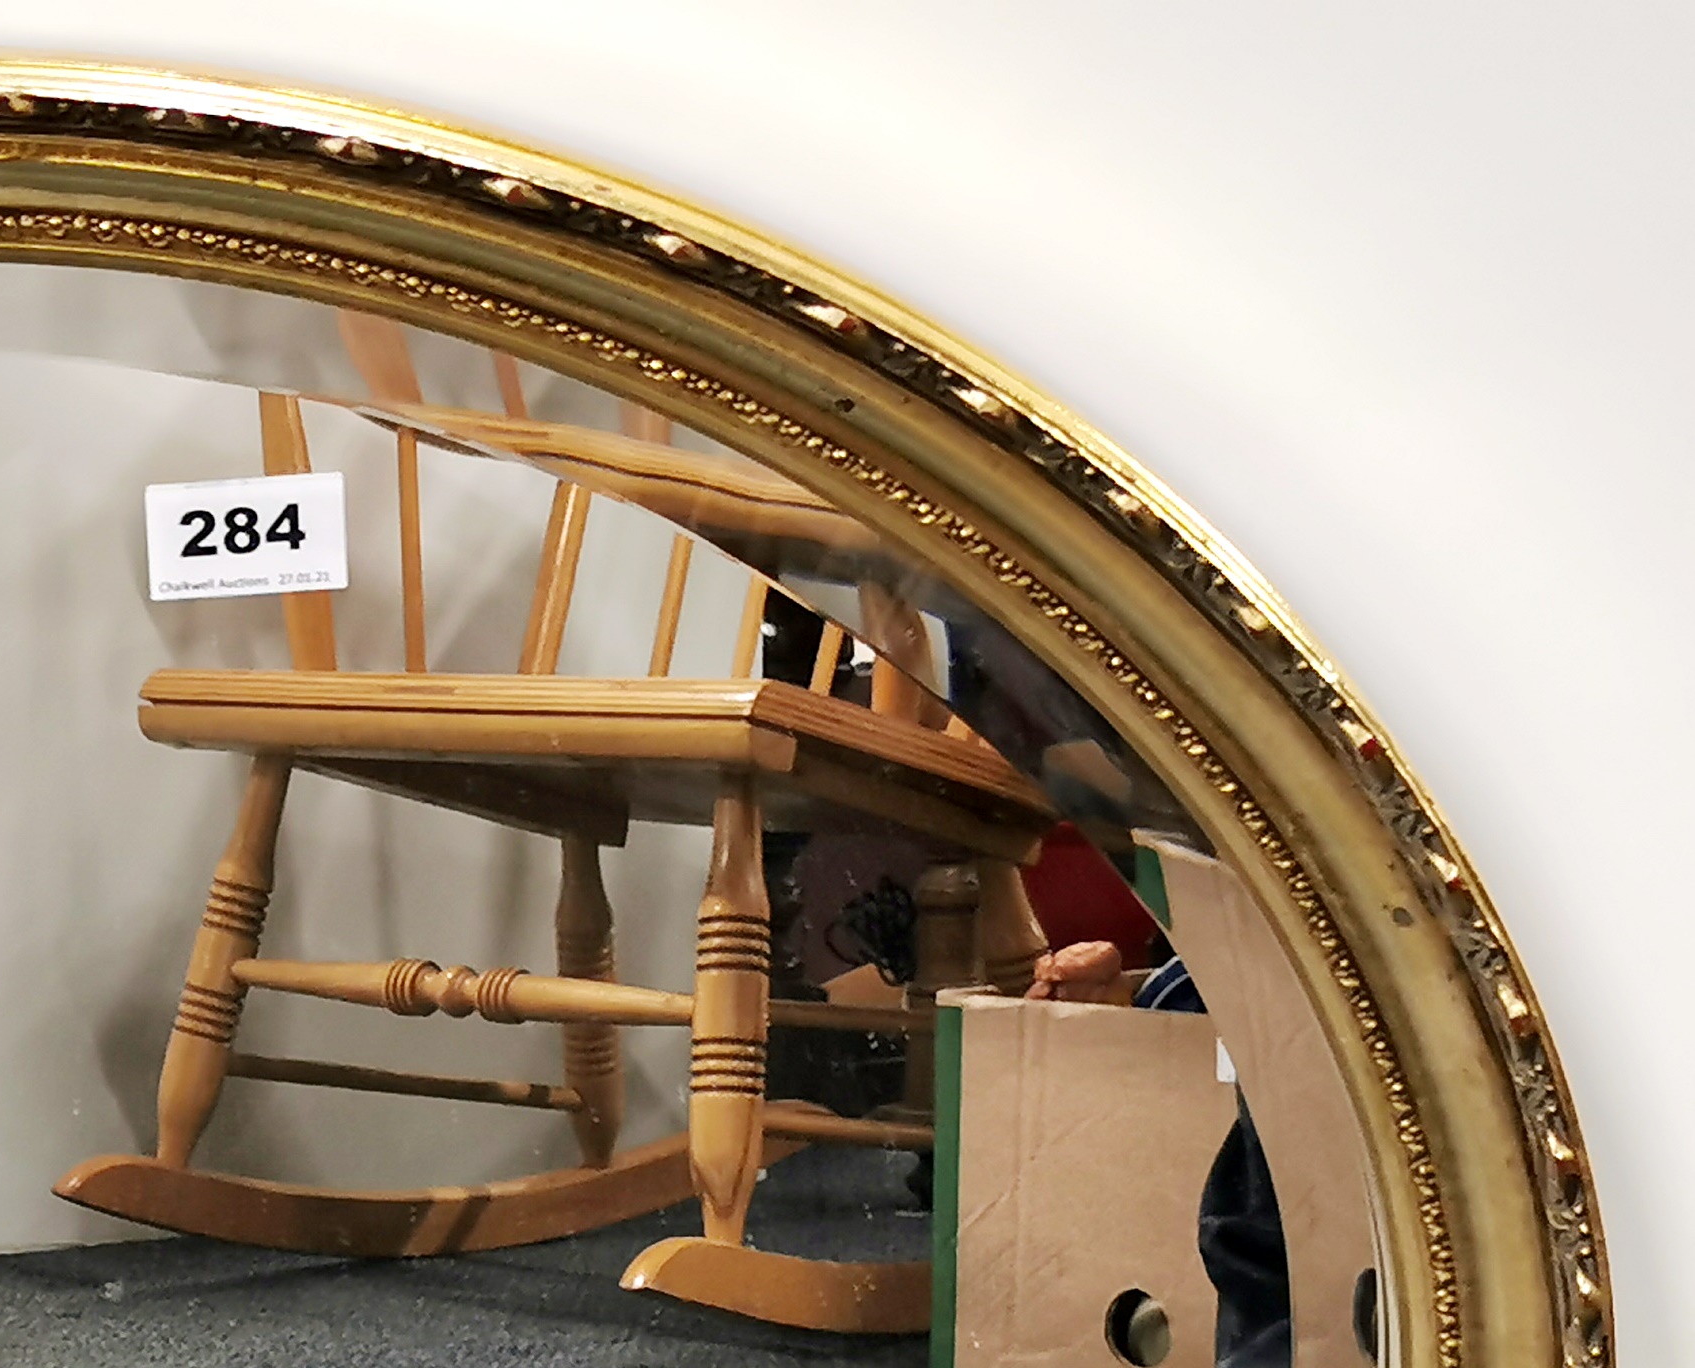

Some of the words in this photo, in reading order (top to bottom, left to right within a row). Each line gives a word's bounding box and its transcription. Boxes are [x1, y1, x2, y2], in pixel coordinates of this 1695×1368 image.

[179, 503, 306, 557] 284
[159, 578, 215, 593] Chalkwell
[219, 576, 269, 588] Auctions
